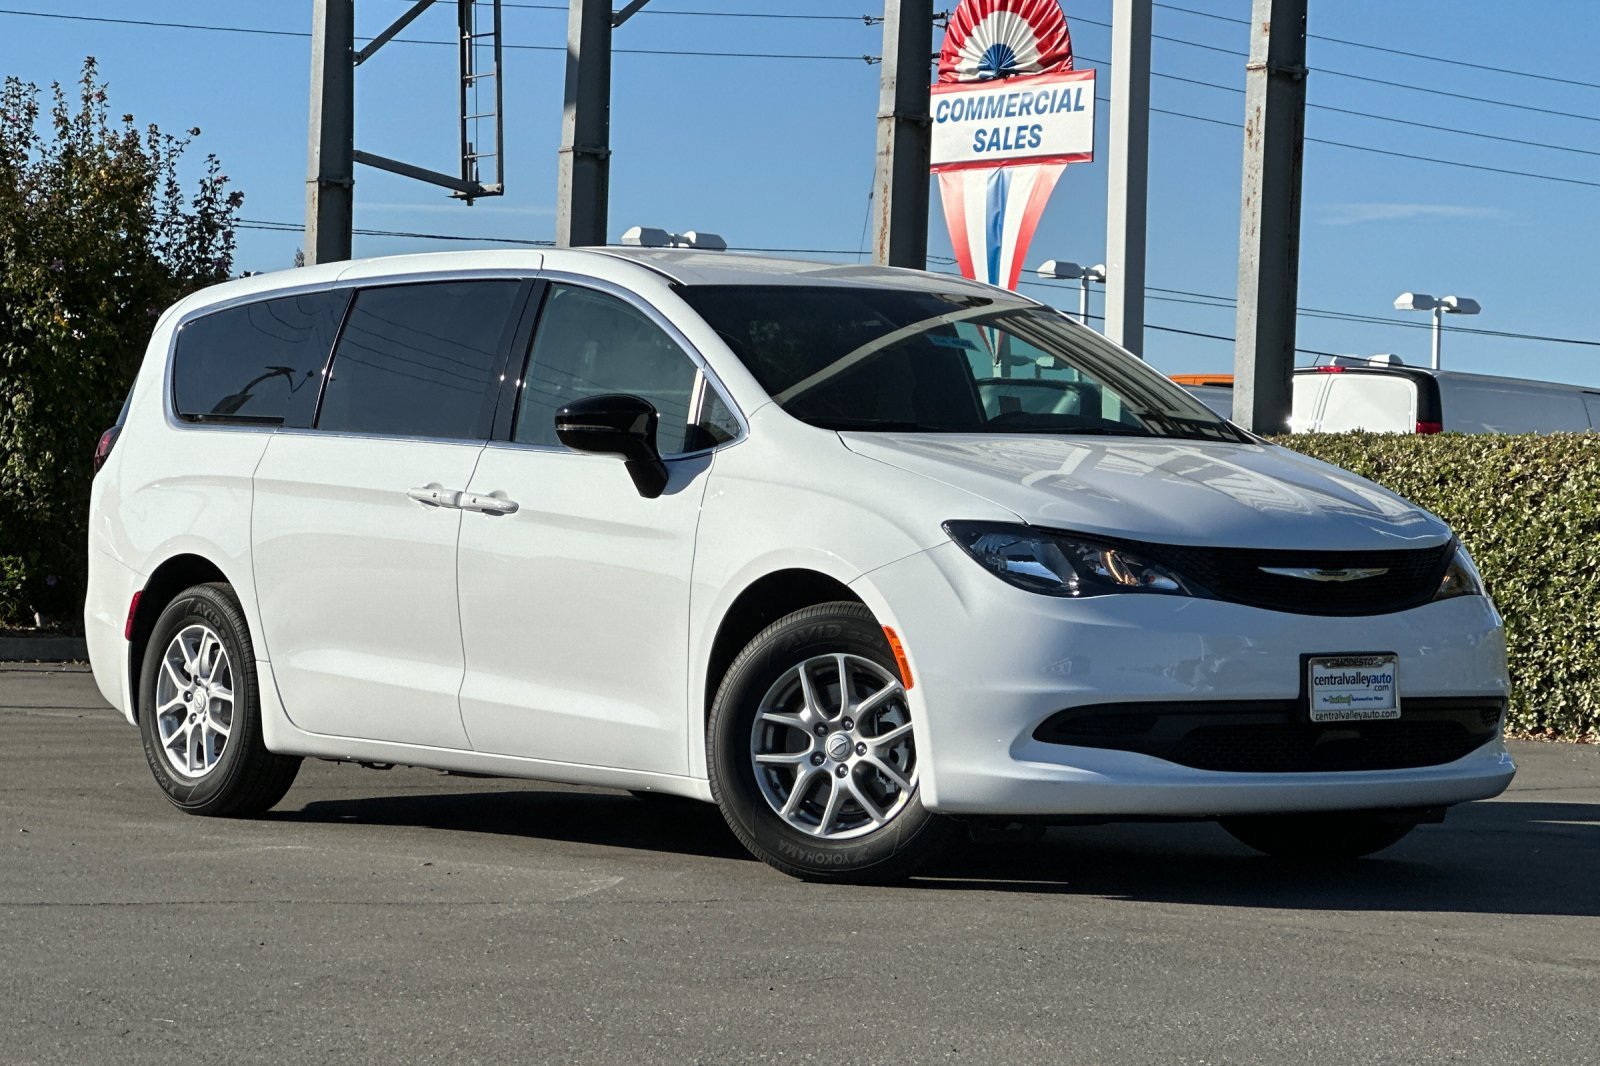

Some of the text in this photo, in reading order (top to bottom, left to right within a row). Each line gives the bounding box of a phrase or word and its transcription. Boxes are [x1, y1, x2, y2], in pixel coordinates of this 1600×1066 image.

[936, 87, 1085, 124] COMMERCIAL
[972, 123, 1043, 153] SALES
[1314, 671, 1392, 688] centralvalleyauto
[1372, 684, 1390, 692] .com
[1315, 709, 1398, 721] centralvalleyauto.com
[777, 838, 850, 866] YOKOHAMA
